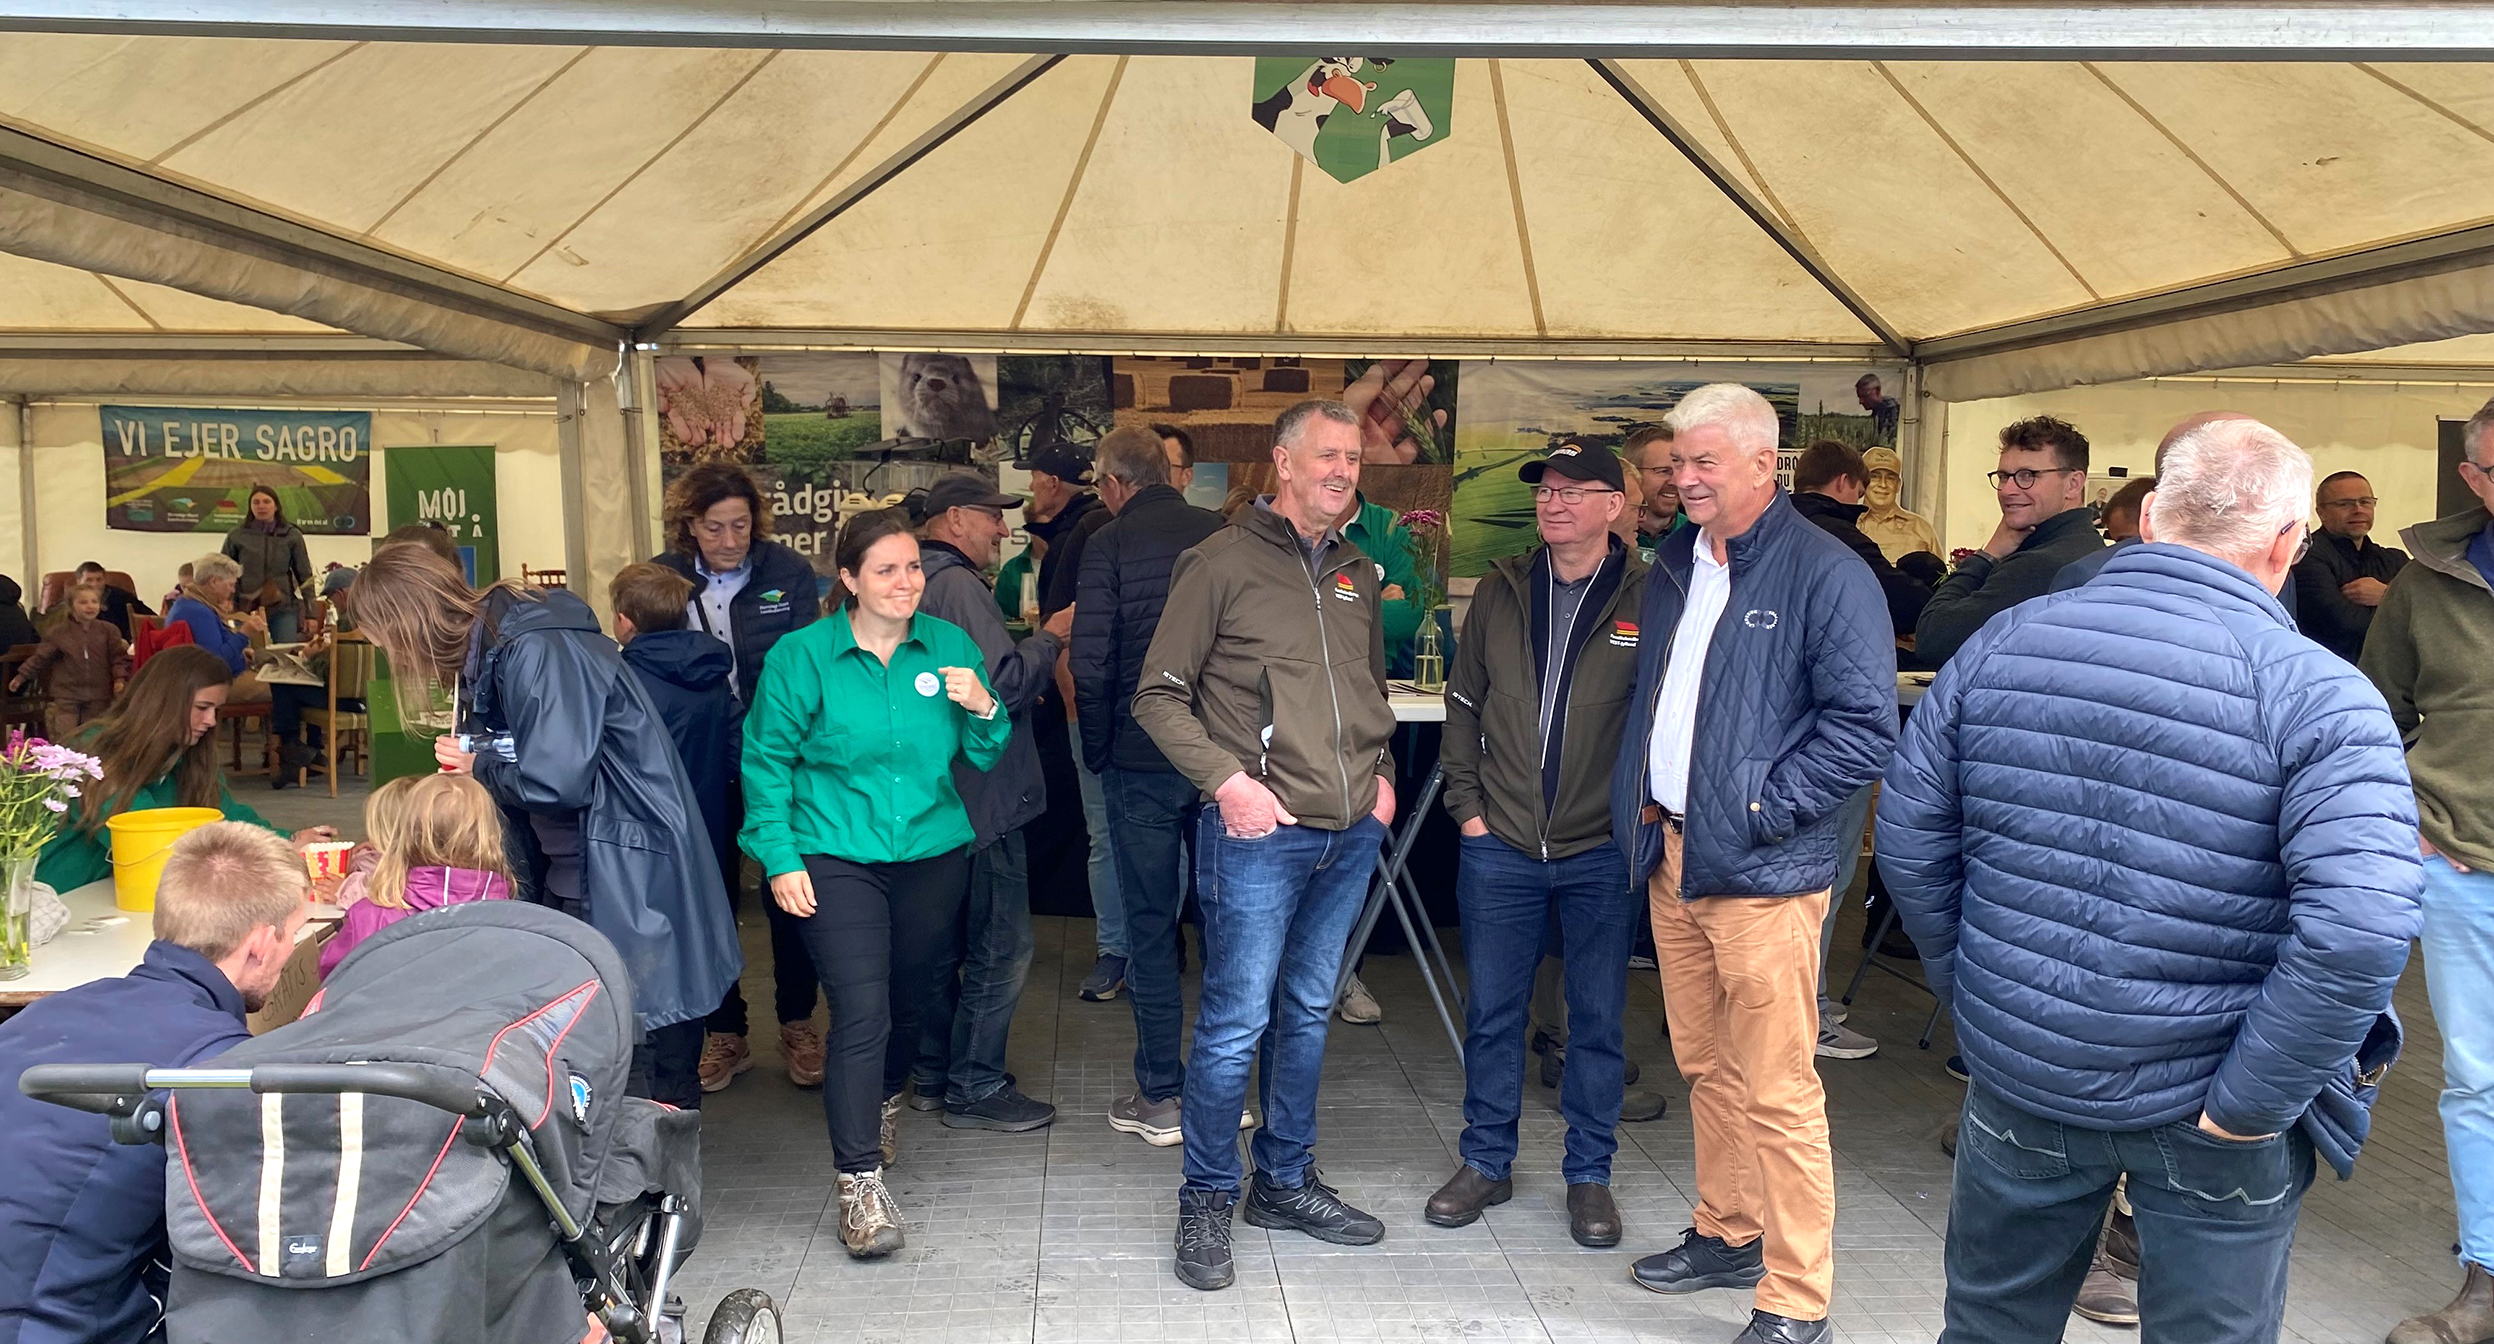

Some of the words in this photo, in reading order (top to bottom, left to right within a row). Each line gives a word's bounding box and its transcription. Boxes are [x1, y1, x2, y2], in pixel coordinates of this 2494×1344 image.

[115, 420, 147, 456] VI
[163, 422, 241, 459] EJER
[256, 424, 357, 462] SAGRO
[764, 480, 849, 523] ådgi
